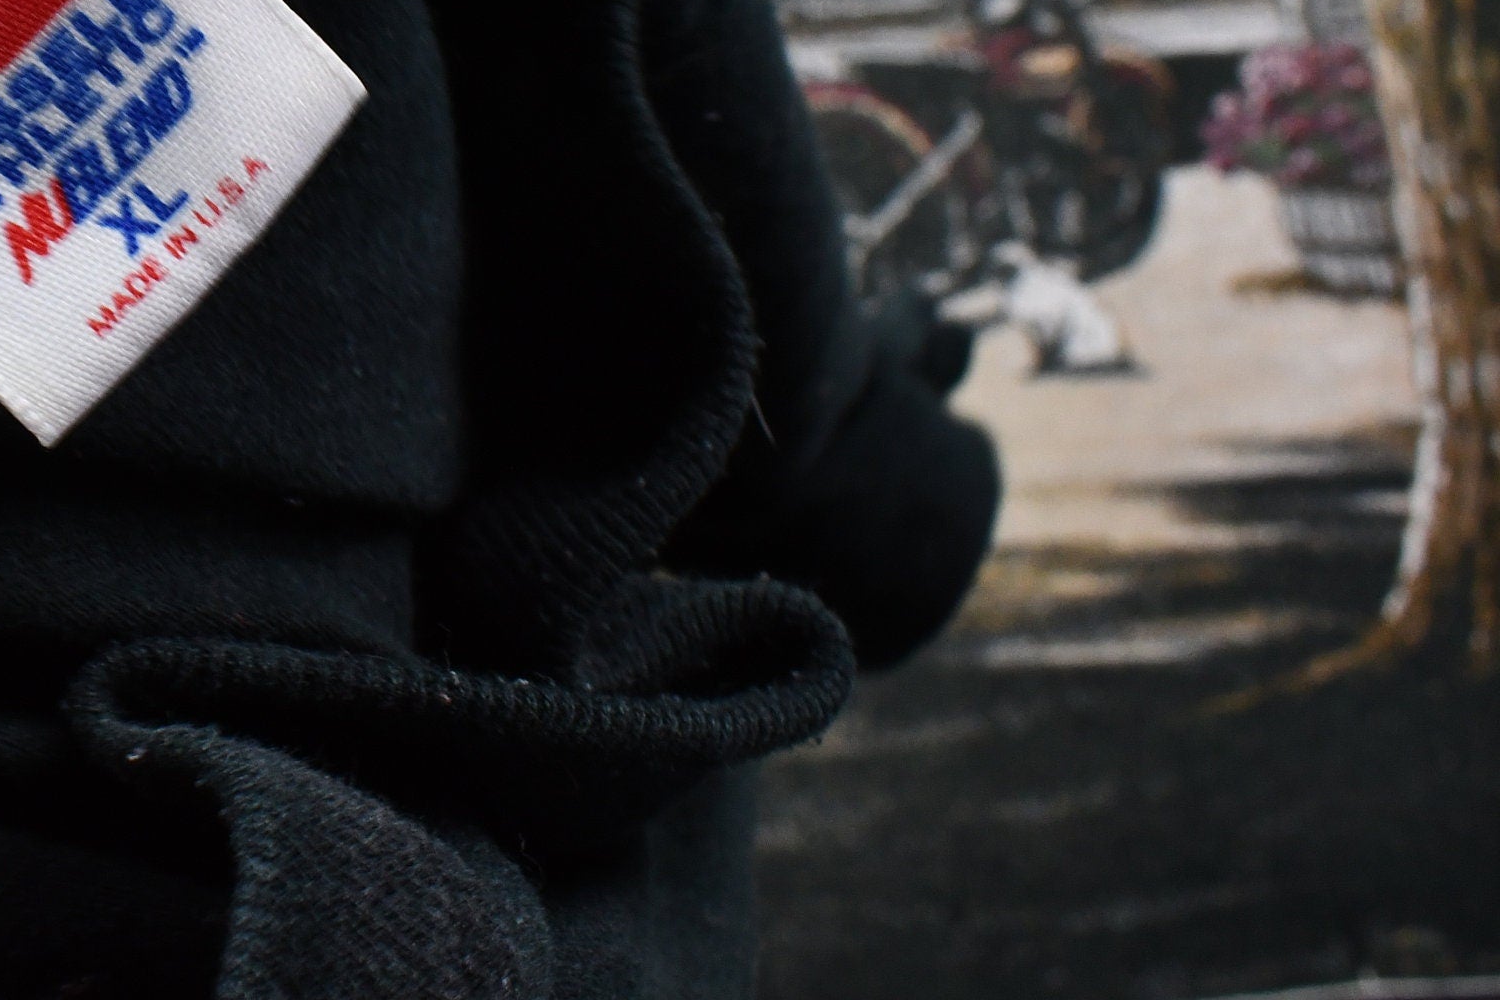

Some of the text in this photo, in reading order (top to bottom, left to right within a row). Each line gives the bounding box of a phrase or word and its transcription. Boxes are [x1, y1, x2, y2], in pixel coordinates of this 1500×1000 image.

[98, 180, 189, 257] XL
[86, 254, 171, 339] MADE
[162, 223, 200, 261] IN
